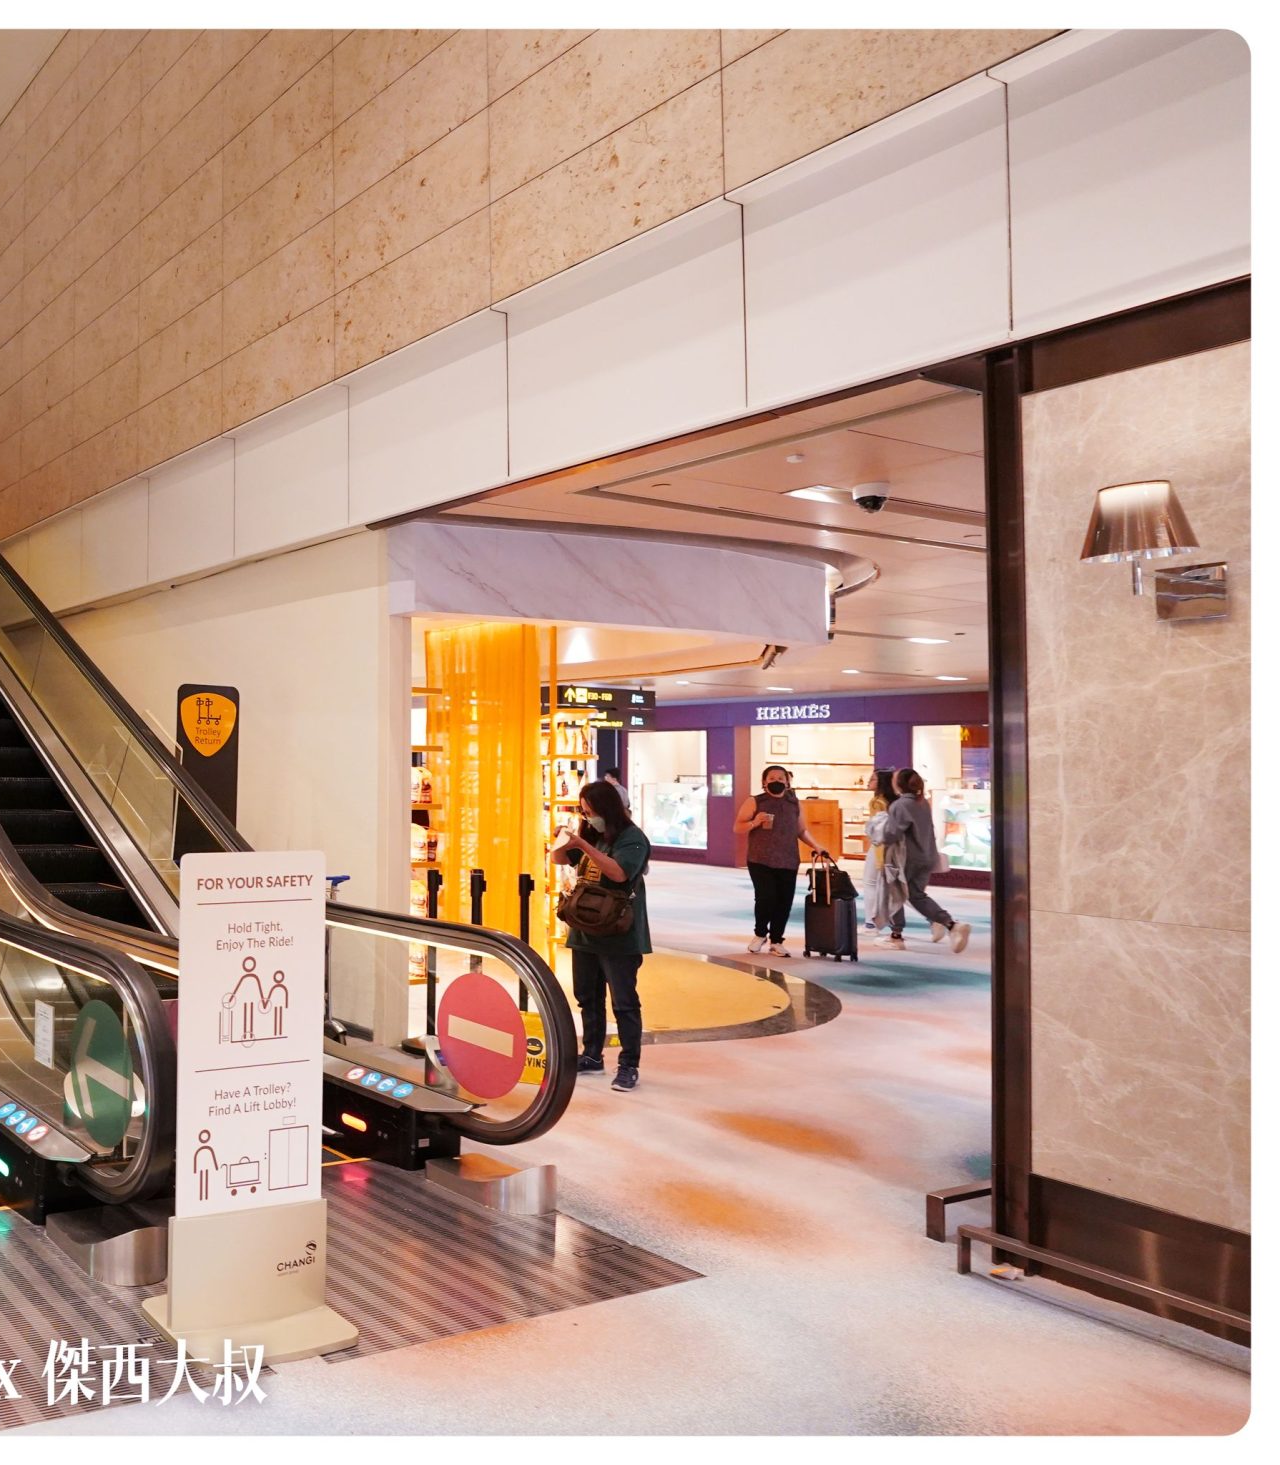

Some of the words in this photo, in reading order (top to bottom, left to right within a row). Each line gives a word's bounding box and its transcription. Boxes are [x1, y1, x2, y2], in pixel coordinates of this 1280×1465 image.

[194, 736, 222, 745] Return
[195, 727, 222, 738] Trolley
[197, 878, 223, 890] FOR
[227, 876, 263, 889] YOUR
[266, 874, 313, 888] SAFETY
[227, 922, 252, 934] Hold
[216, 939, 244, 952] Enjoy
[247, 937, 266, 949] The
[268, 935, 294, 948] Ride!
[214, 1088, 241, 1101] Have
[243, 1086, 251, 1097] A
[254, 1081, 291, 1096] Trolley?
[208, 1104, 231, 1117] Find
[233, 1103, 242, 1113] A
[244, 1100, 261, 1113] Lift
[263, 1097, 297, 1111] Lobby!
[276, 1255, 316, 1272] CHANGI
